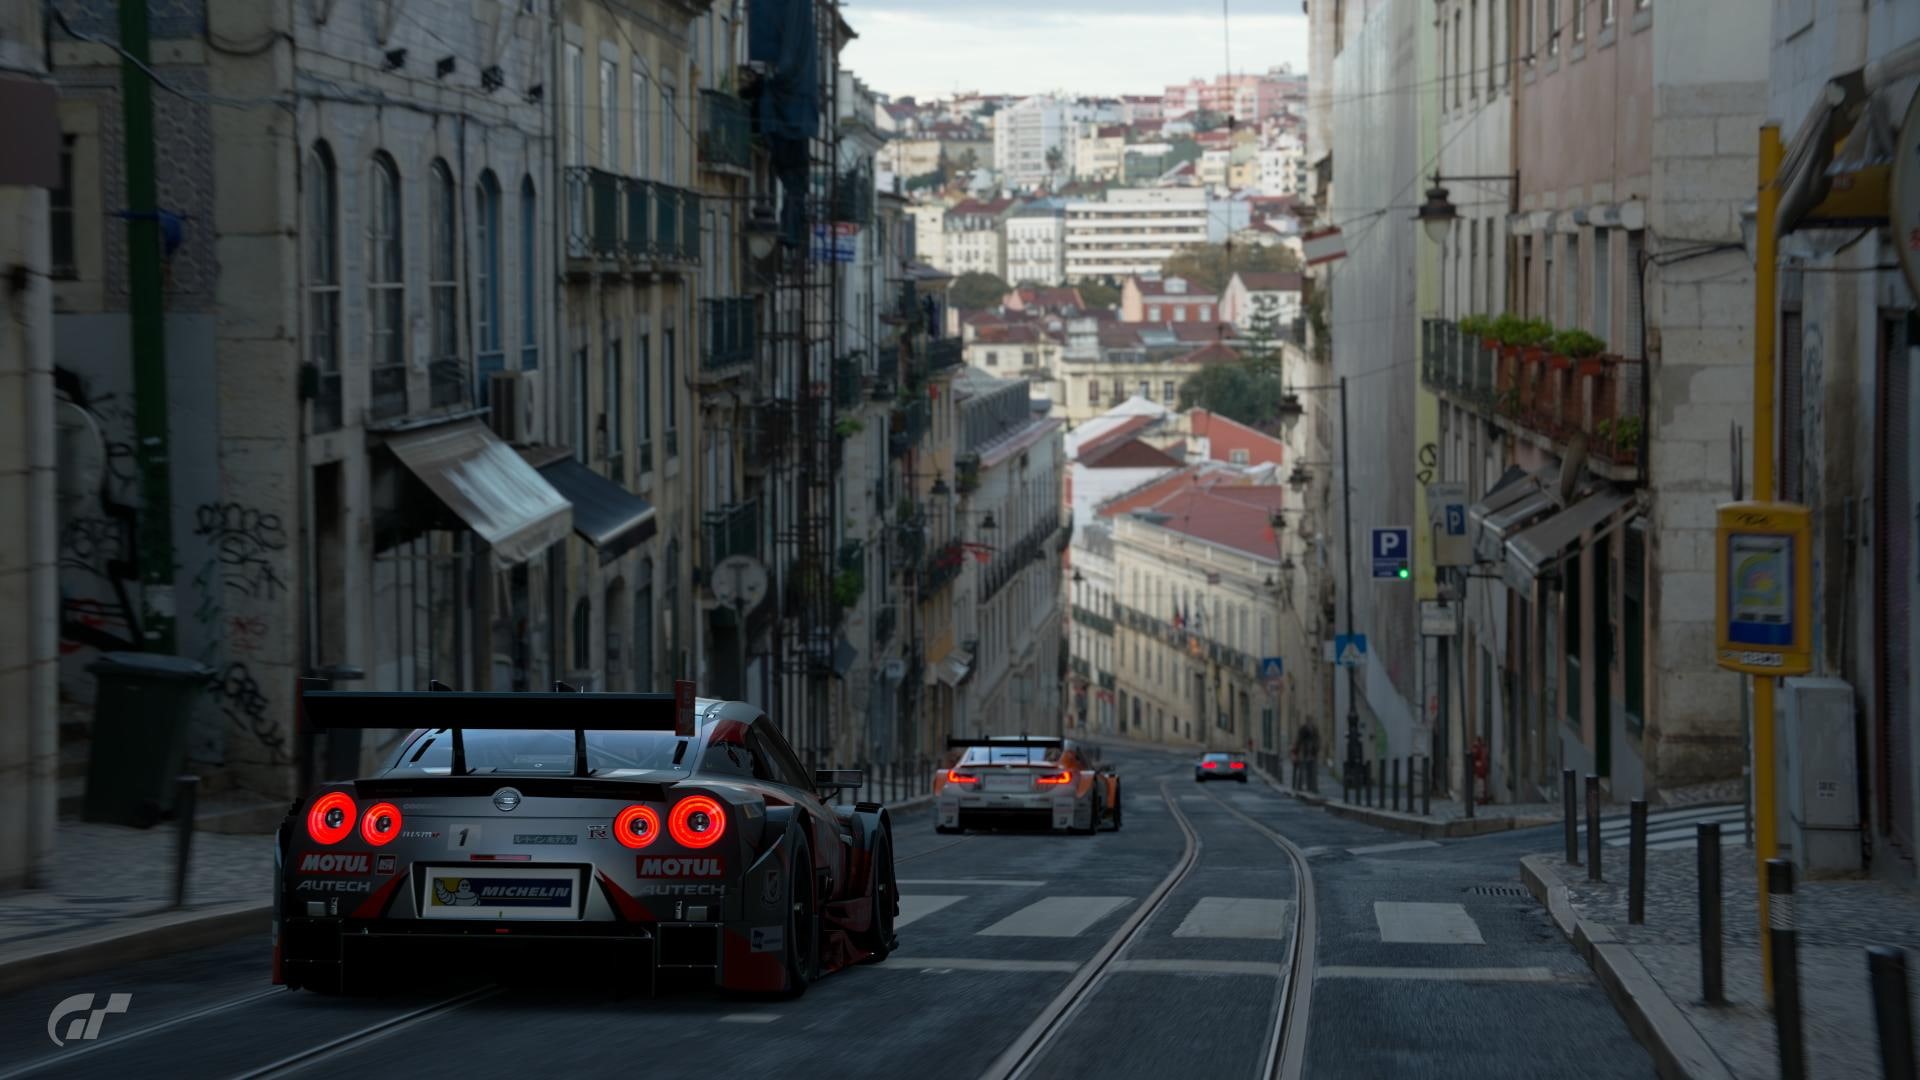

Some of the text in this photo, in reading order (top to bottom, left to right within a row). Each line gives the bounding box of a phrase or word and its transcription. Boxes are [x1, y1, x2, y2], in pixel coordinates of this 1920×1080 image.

[1449, 510, 1462, 533] P
[1380, 532, 1400, 557] P
[457, 827, 470, 847] 1
[300, 854, 370, 873] MOTUL
[639, 858, 722, 877] MOTUL
[296, 879, 371, 893] AUTECH
[481, 885, 572, 898] MICHELIN
[640, 882, 726, 896] AUTECH
